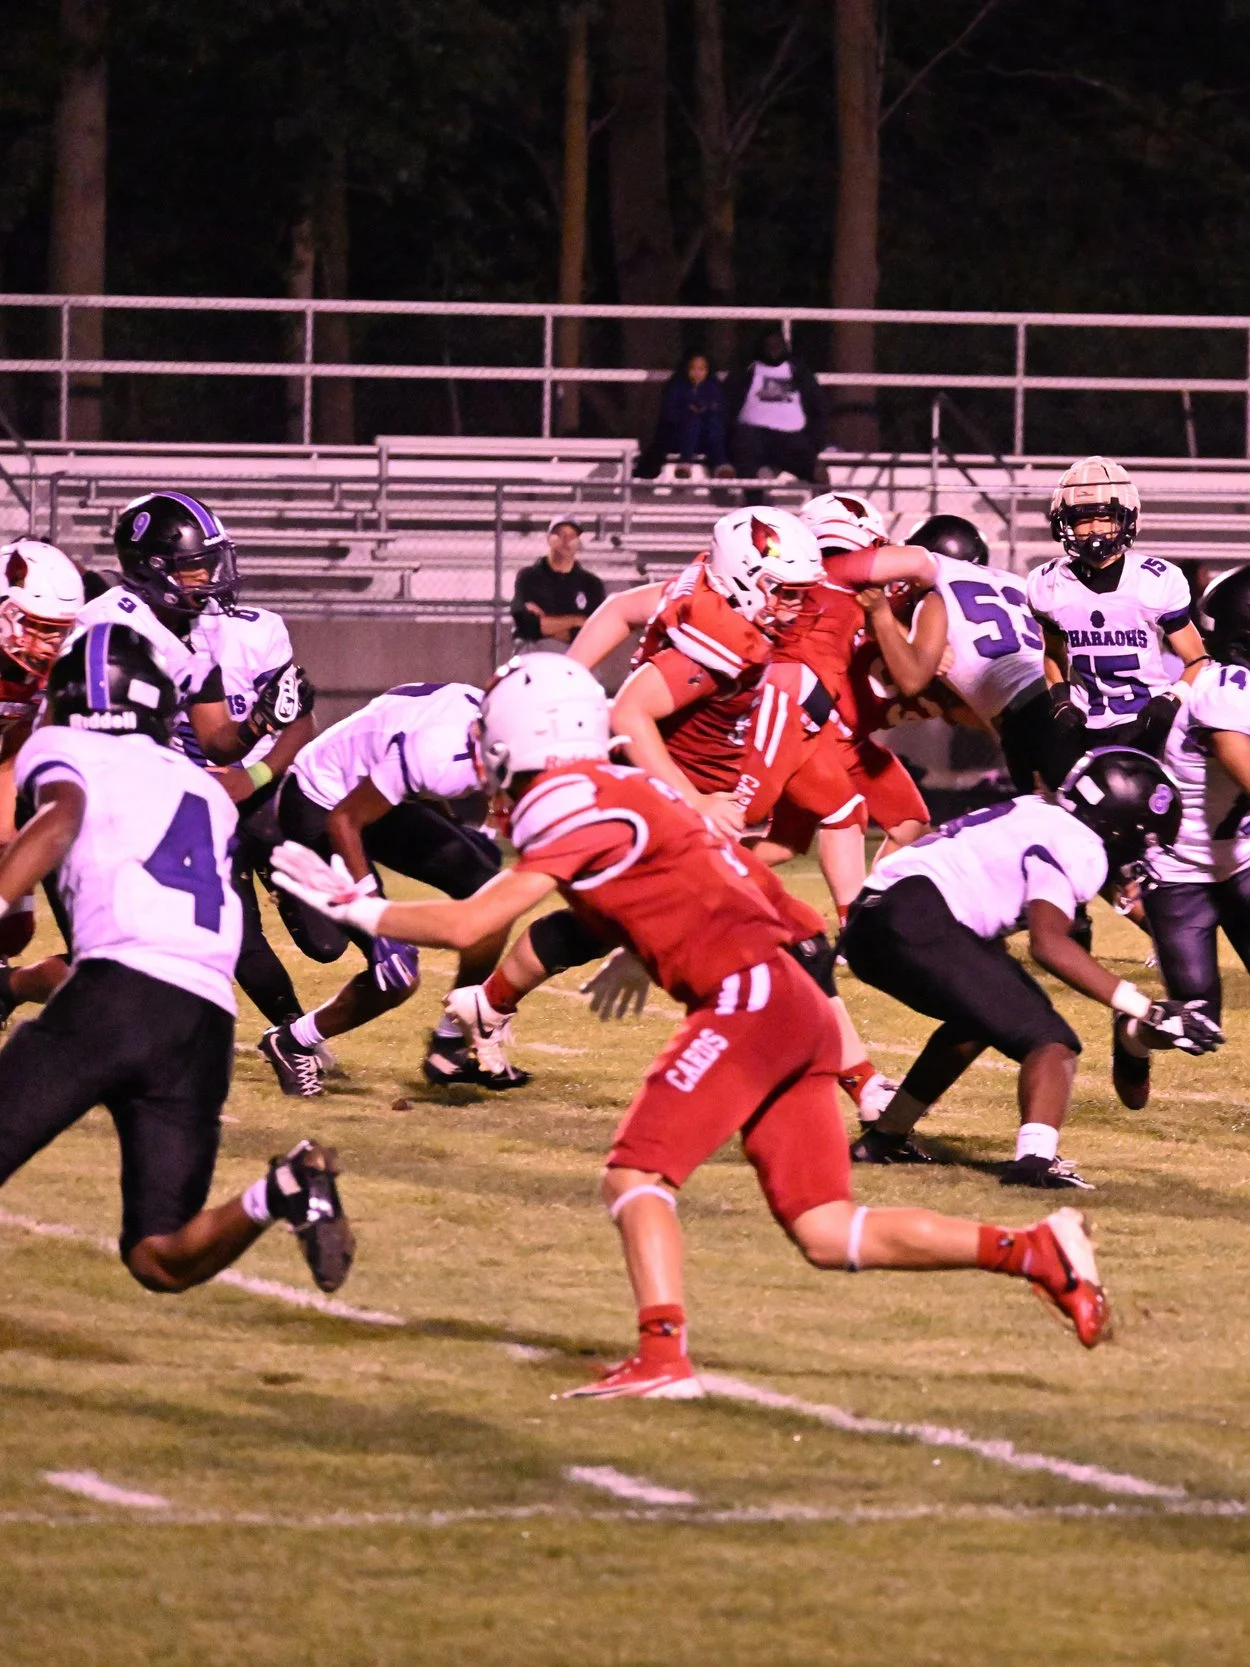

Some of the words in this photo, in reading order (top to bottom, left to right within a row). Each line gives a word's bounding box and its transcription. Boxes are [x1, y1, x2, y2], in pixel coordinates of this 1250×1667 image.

[131, 512, 151, 541] 9
[1140, 557, 1167, 578] 15
[1066, 629, 1147, 649] HARAOHS
[1071, 653, 1152, 716] 15
[1219, 668, 1247, 691] 14
[1149, 783, 1174, 815] 8
[143, 791, 225, 933] 4
[665, 1027, 729, 1093] CARDS
